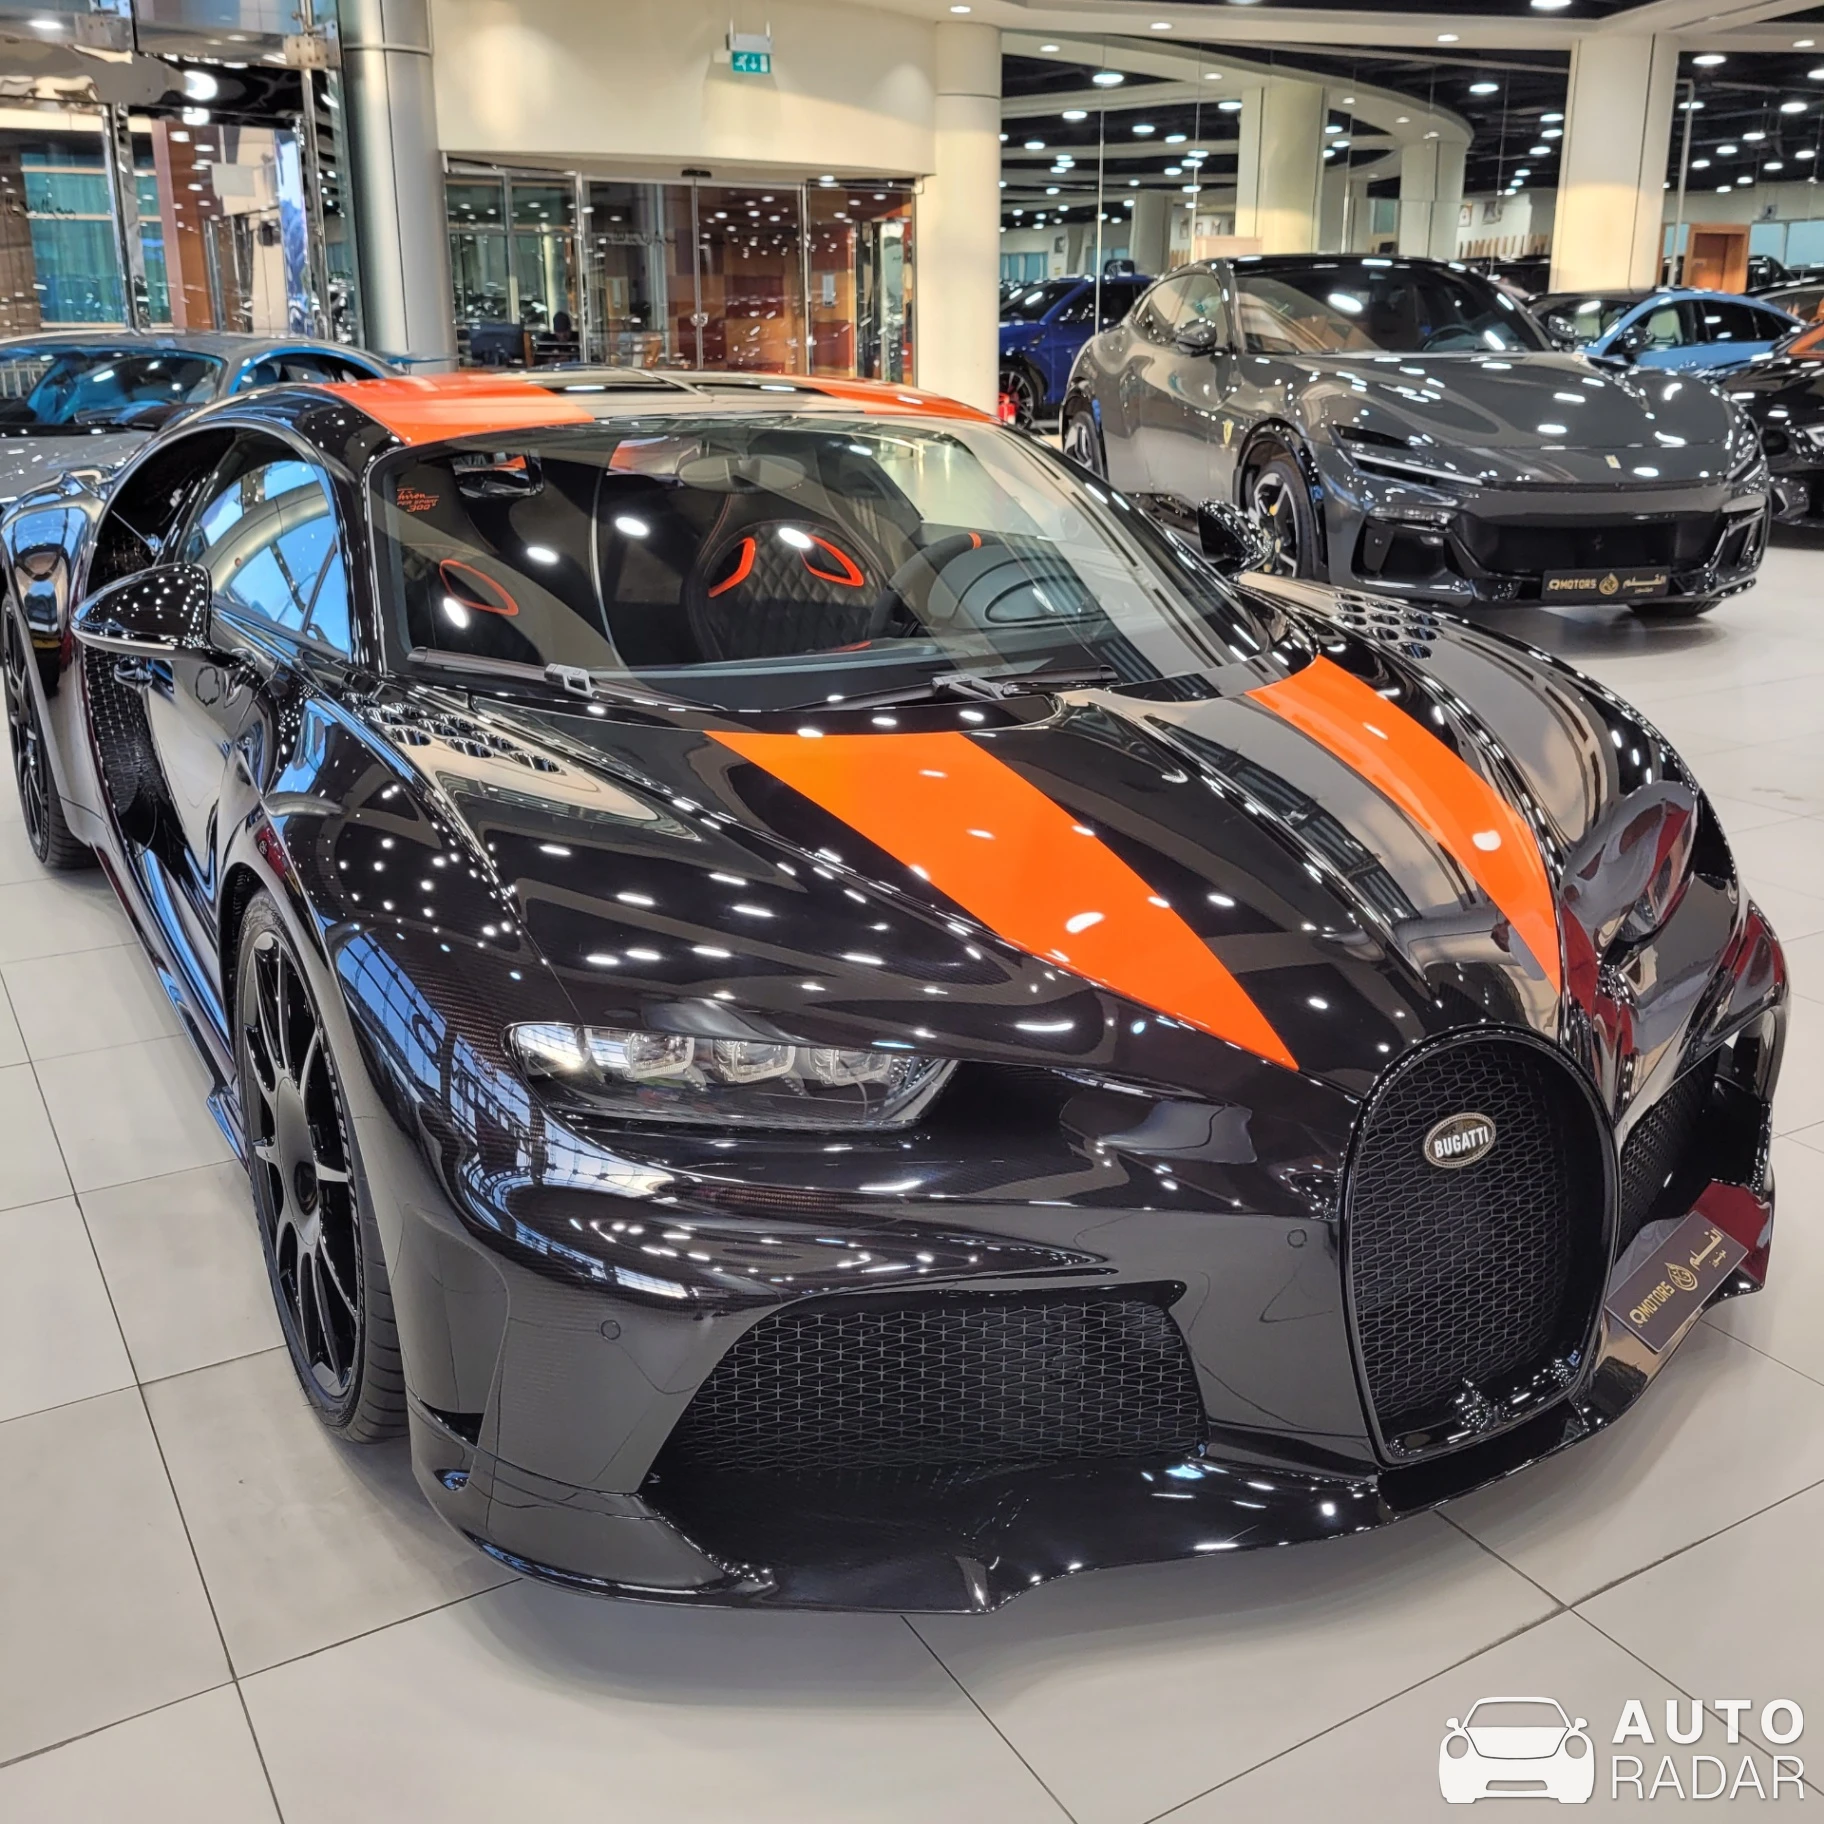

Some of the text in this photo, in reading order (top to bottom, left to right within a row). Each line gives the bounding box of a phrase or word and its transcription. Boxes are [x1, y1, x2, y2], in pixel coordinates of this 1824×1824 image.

[1547, 578, 1597, 591] QMOTORS
[323, 1051, 359, 1228] MICHELIN
[1434, 1126, 1489, 1158] BUGATTI
[1629, 1280, 1676, 1328] QMOTORS
